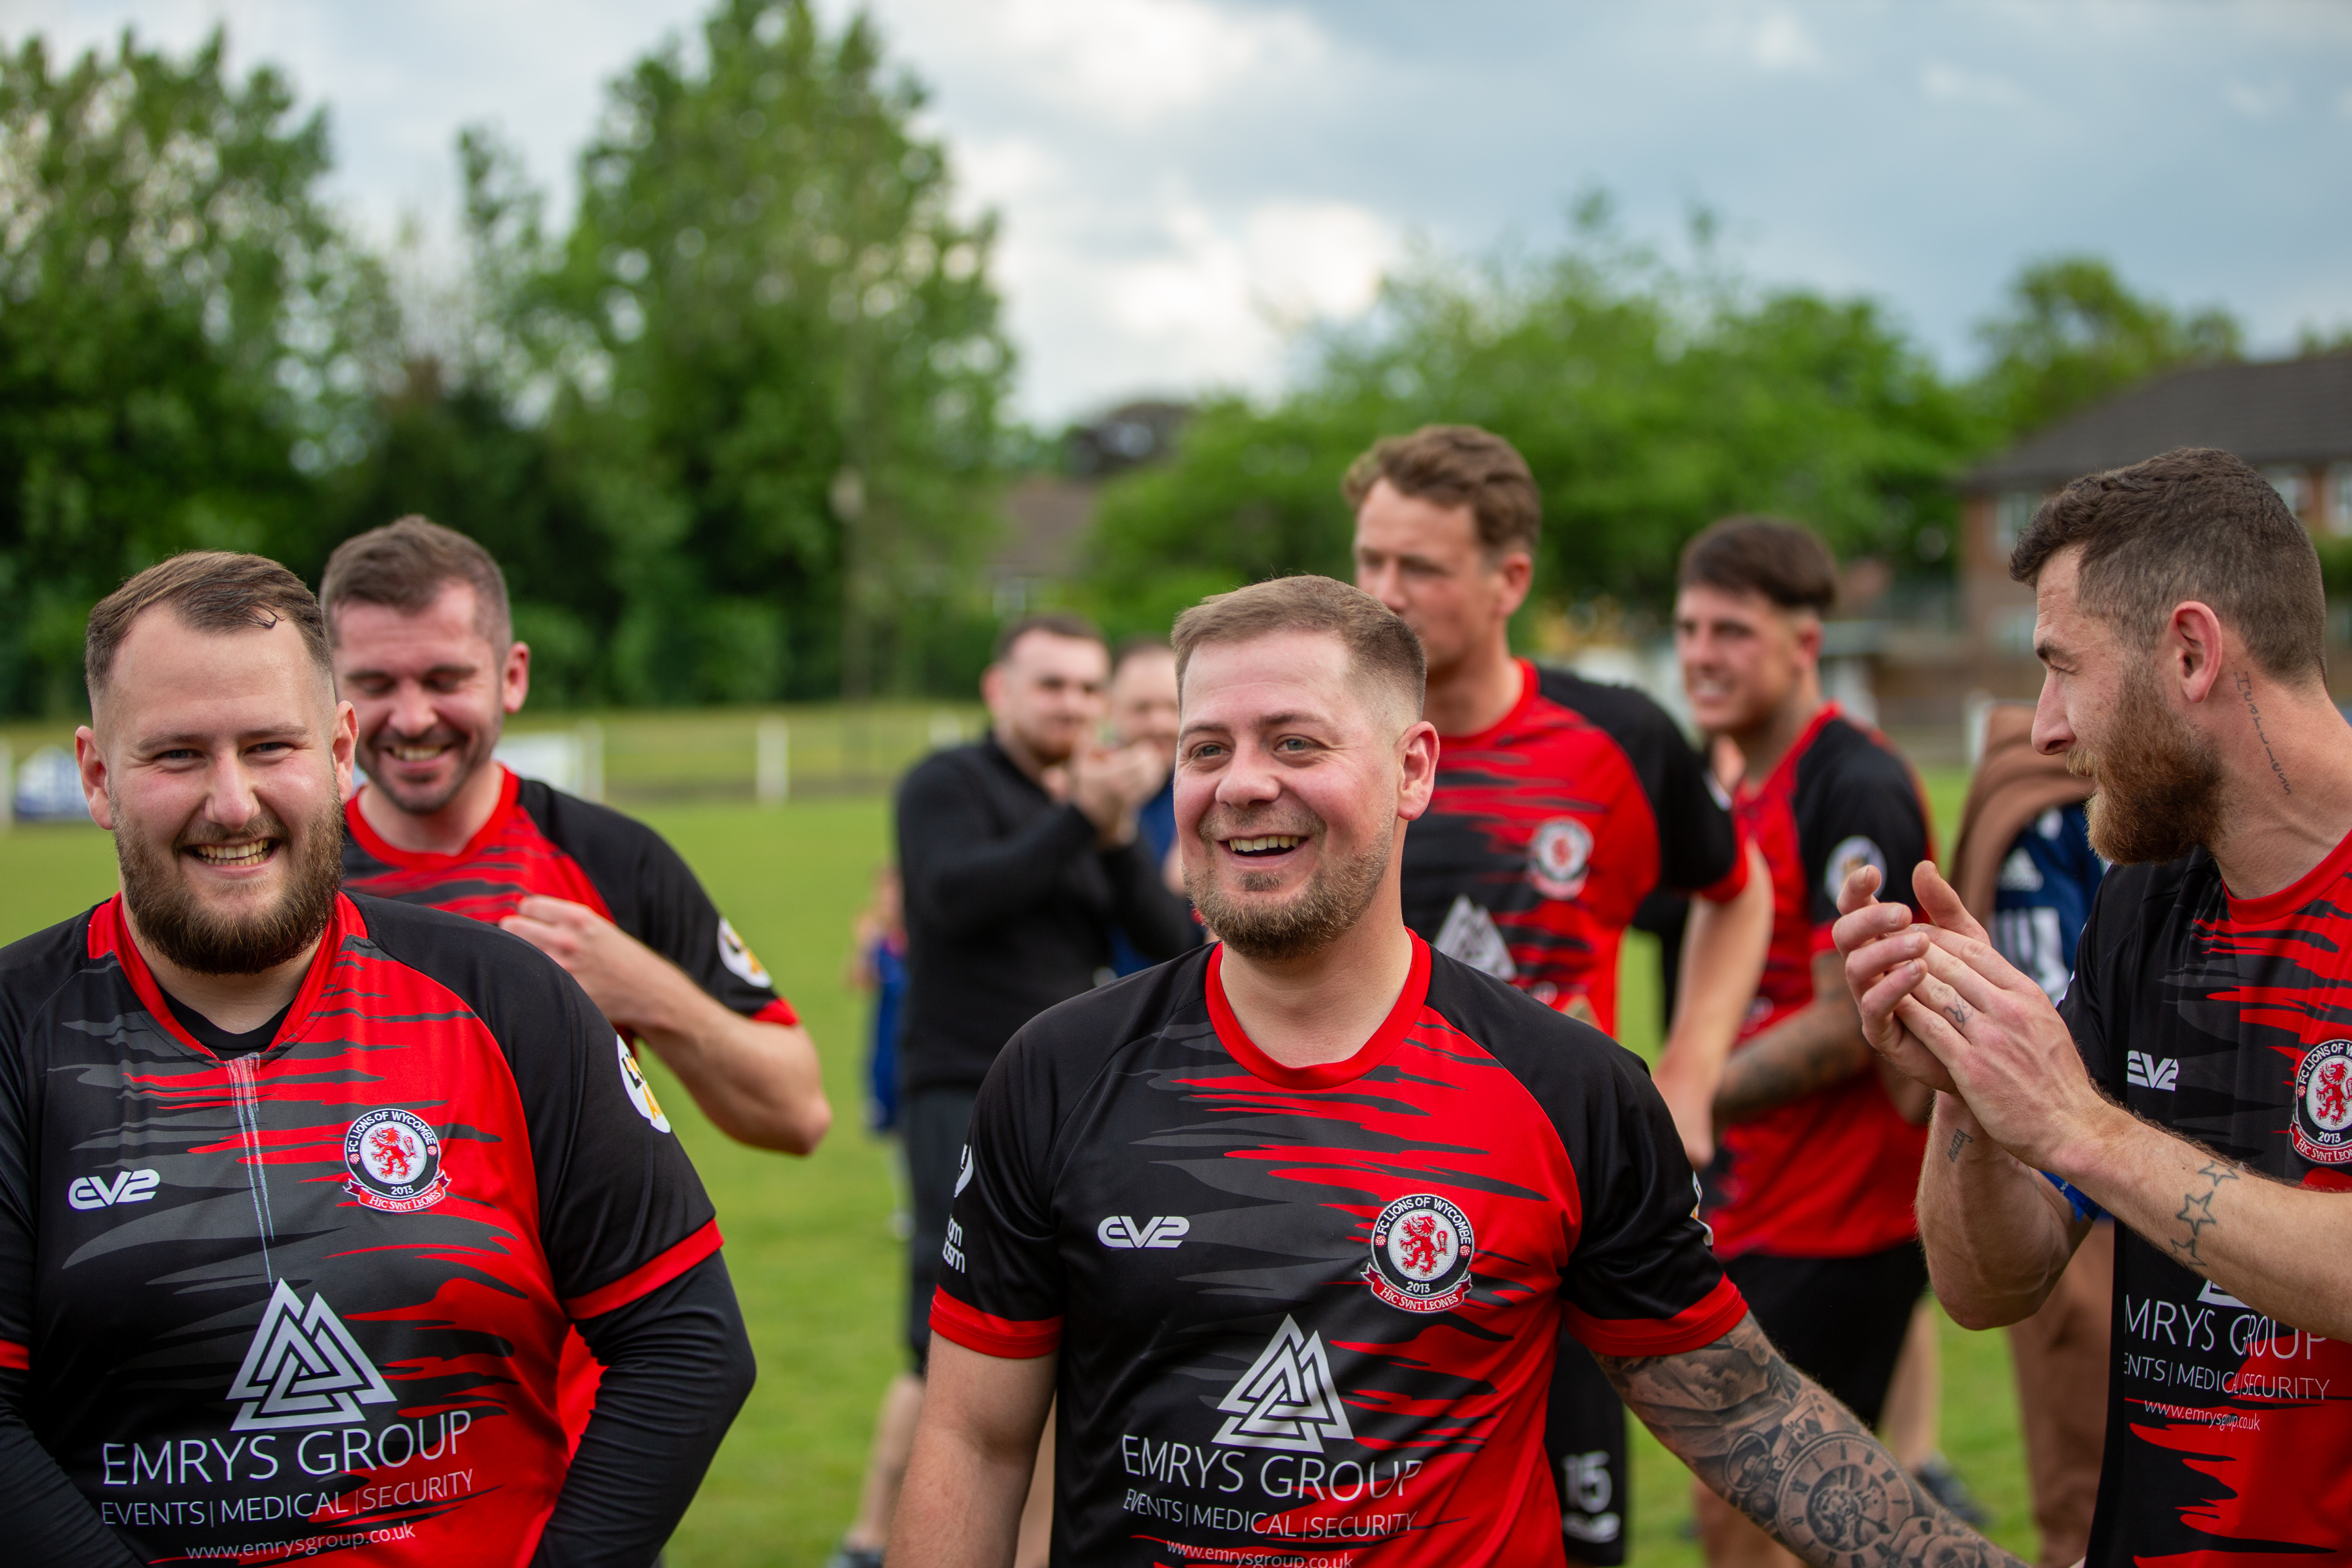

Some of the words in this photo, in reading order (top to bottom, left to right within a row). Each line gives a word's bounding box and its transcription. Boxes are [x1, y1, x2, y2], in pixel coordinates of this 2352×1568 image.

[2303, 1045, 2331, 1069] LIONS
[2331, 1043, 2345, 1054] OF
[2299, 1069, 2309, 1084] FC
[352, 1116, 375, 1139] LIONS
[374, 1112, 388, 1121] OF
[391, 1111, 436, 1146] WYCOMBE
[348, 1140, 358, 1152] FC
[2318, 1131, 2341, 1144] 2013
[391, 1185, 414, 1195] 2013
[1377, 1221, 1390, 1236] FC
[1384, 1199, 1414, 1223] LIONS
[1415, 1197, 1431, 1208] OF
[1434, 1198, 1471, 1245] WYCOMBE
[1406, 1281, 1430, 1294] 2013
[2125, 1294, 2215, 1352] MRYS
[103, 1432, 279, 1485] EMRYS
[296, 1410, 472, 1475] GROUP
[1122, 1434, 1246, 1493] EMRYS
[1260, 1455, 1423, 1502] GROUP
[1562, 1451, 1613, 1513] 15
[185, 1521, 416, 1560] www.emrysgroup.co.uk
[1166, 1539, 1352, 1568] www.emrysgroup.co.uk
